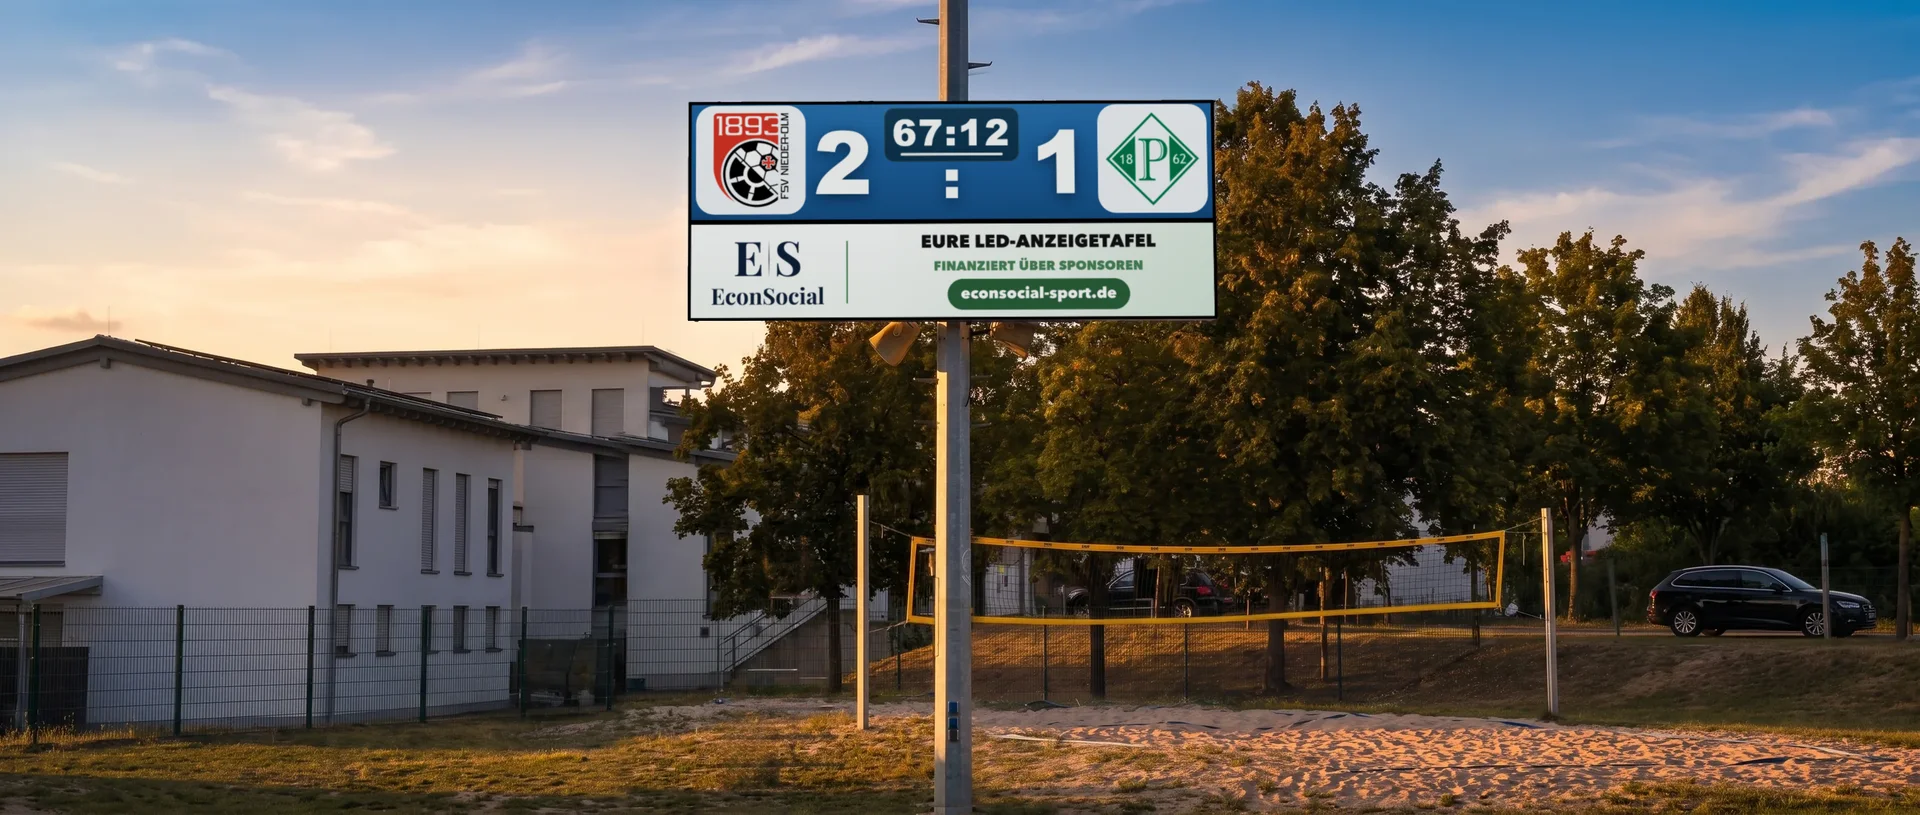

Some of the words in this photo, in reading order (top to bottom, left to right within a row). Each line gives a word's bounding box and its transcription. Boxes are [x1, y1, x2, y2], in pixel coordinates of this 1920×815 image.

[716, 115, 778, 136] 1893
[893, 118, 1008, 147] 67:12
[781, 112, 789, 175] NIEDER-OLM
[815, 130, 869, 195] 2
[1037, 129, 1076, 194] 1
[1119, 153, 1133, 165] 18
[1138, 138, 1168, 181] P
[1172, 153, 1187, 165] 62
[781, 179, 789, 199] FSV
[921, 234, 970, 248] EURE
[975, 233, 1156, 248] LED-ANZEIGETAFEL
[934, 260, 1016, 271] FINANZIERT
[1019, 257, 1055, 271] ÜBER
[1059, 259, 1143, 271] SPONSOREN
[711, 286, 824, 306] EconSocial
[960, 285, 1117, 303] econsocial-sport.de
